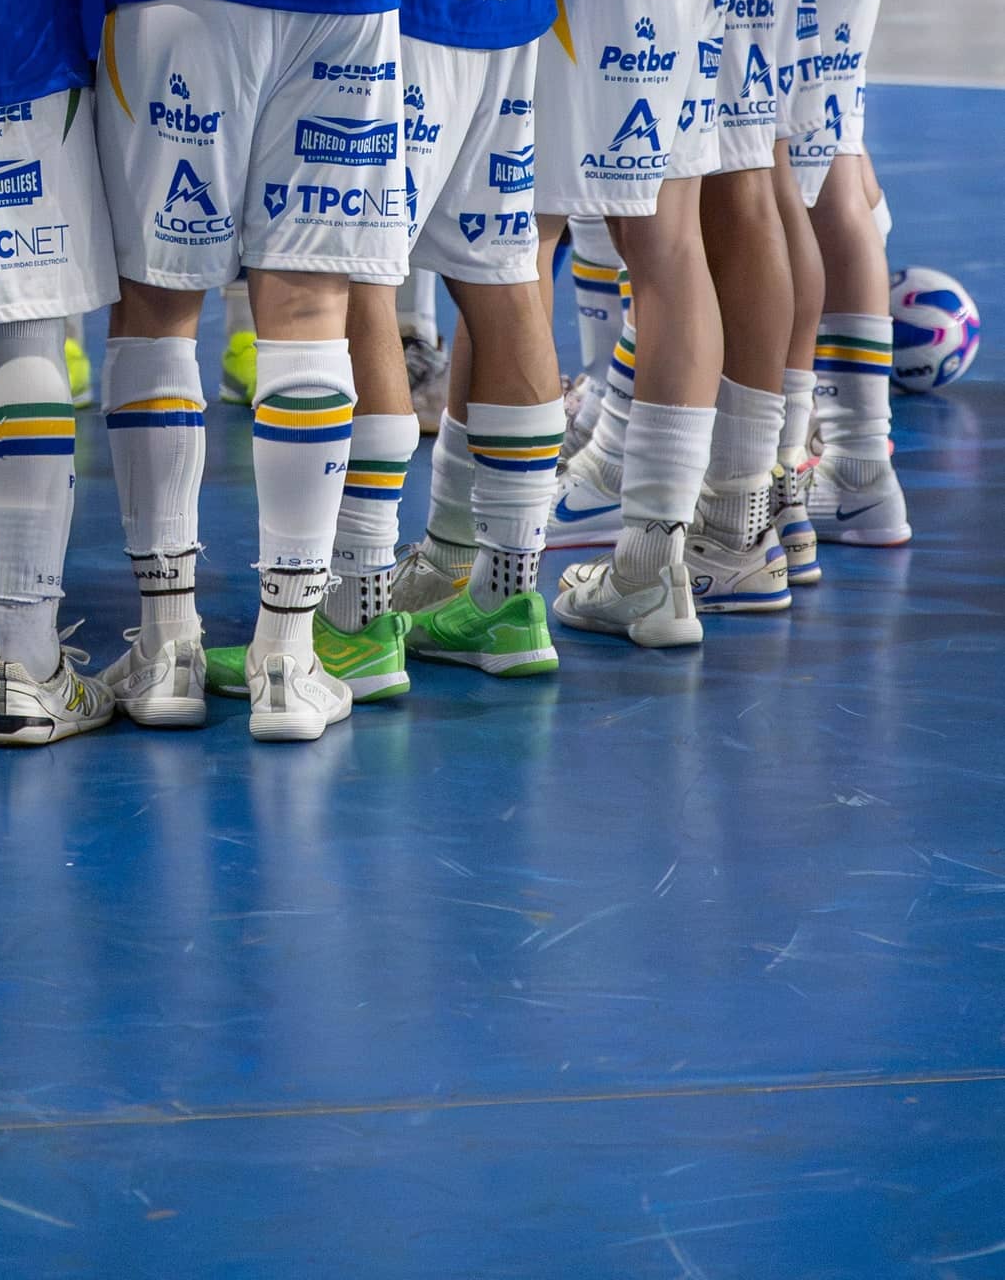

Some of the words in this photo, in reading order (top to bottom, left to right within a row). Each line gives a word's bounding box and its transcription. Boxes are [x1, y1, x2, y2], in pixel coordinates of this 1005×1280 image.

[599, 44, 676, 72] Petba
[338, 85, 372, 97] PARK
[604, 74, 640, 84] buenos
[149, 101, 221, 134] Petba
[405, 114, 440, 143] tba
[301, 128, 346, 152] ALFREDO
[349, 133, 395, 155] PUGLIESE
[584, 170, 635, 181] SOLUCIONES
